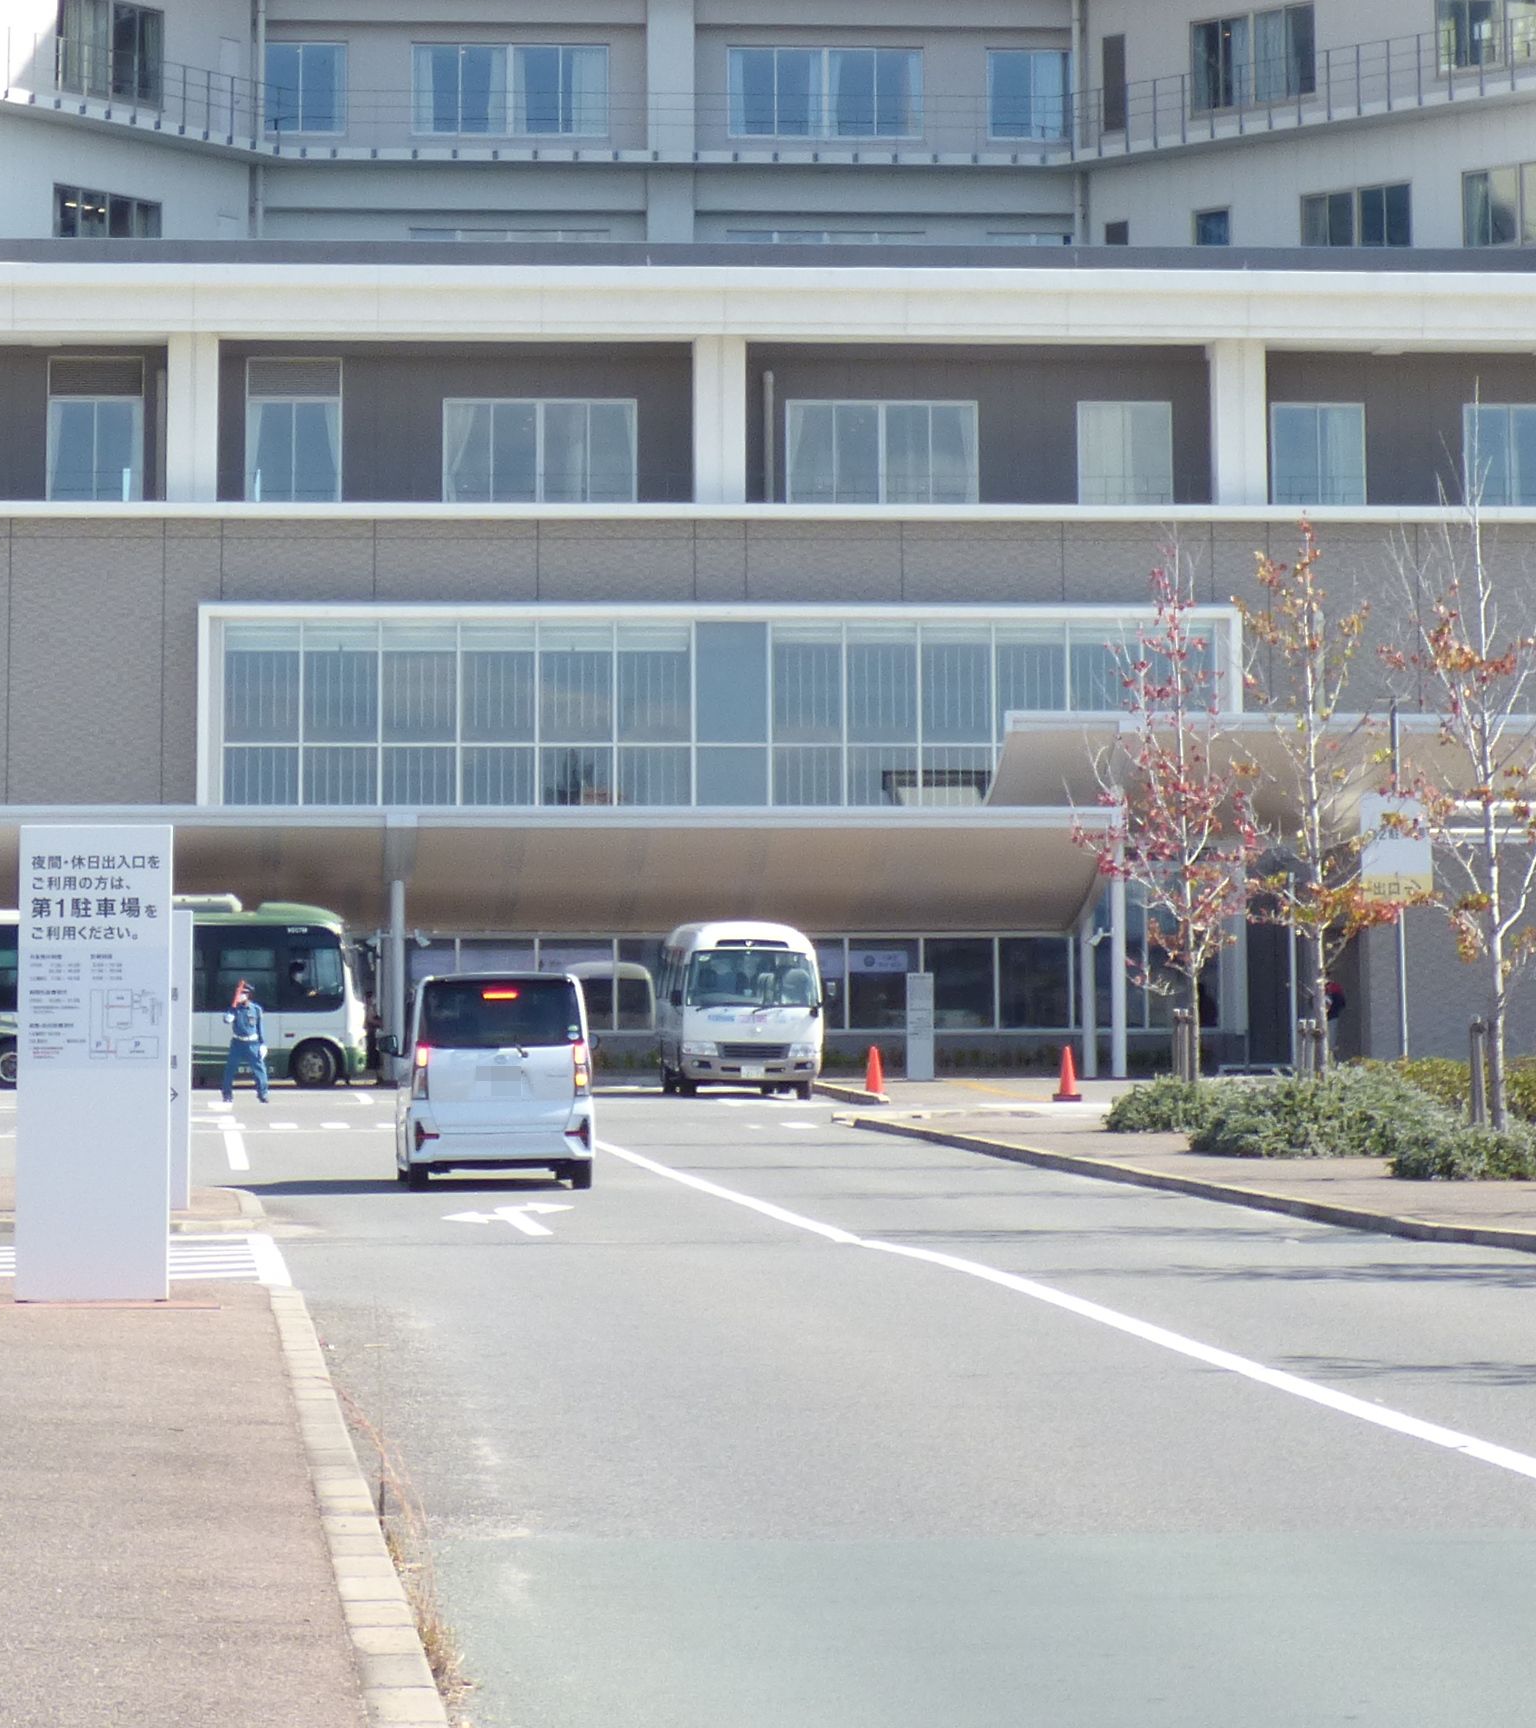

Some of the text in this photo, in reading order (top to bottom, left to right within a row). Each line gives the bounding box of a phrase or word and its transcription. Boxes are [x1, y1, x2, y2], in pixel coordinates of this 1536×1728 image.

[31, 855, 160, 870] 夜間・休日出入口を
[32, 876, 131, 891] ご利用の方は、
[31, 897, 157, 919] 第1駐車場を
[31, 926, 138, 941] ご利用ください。
